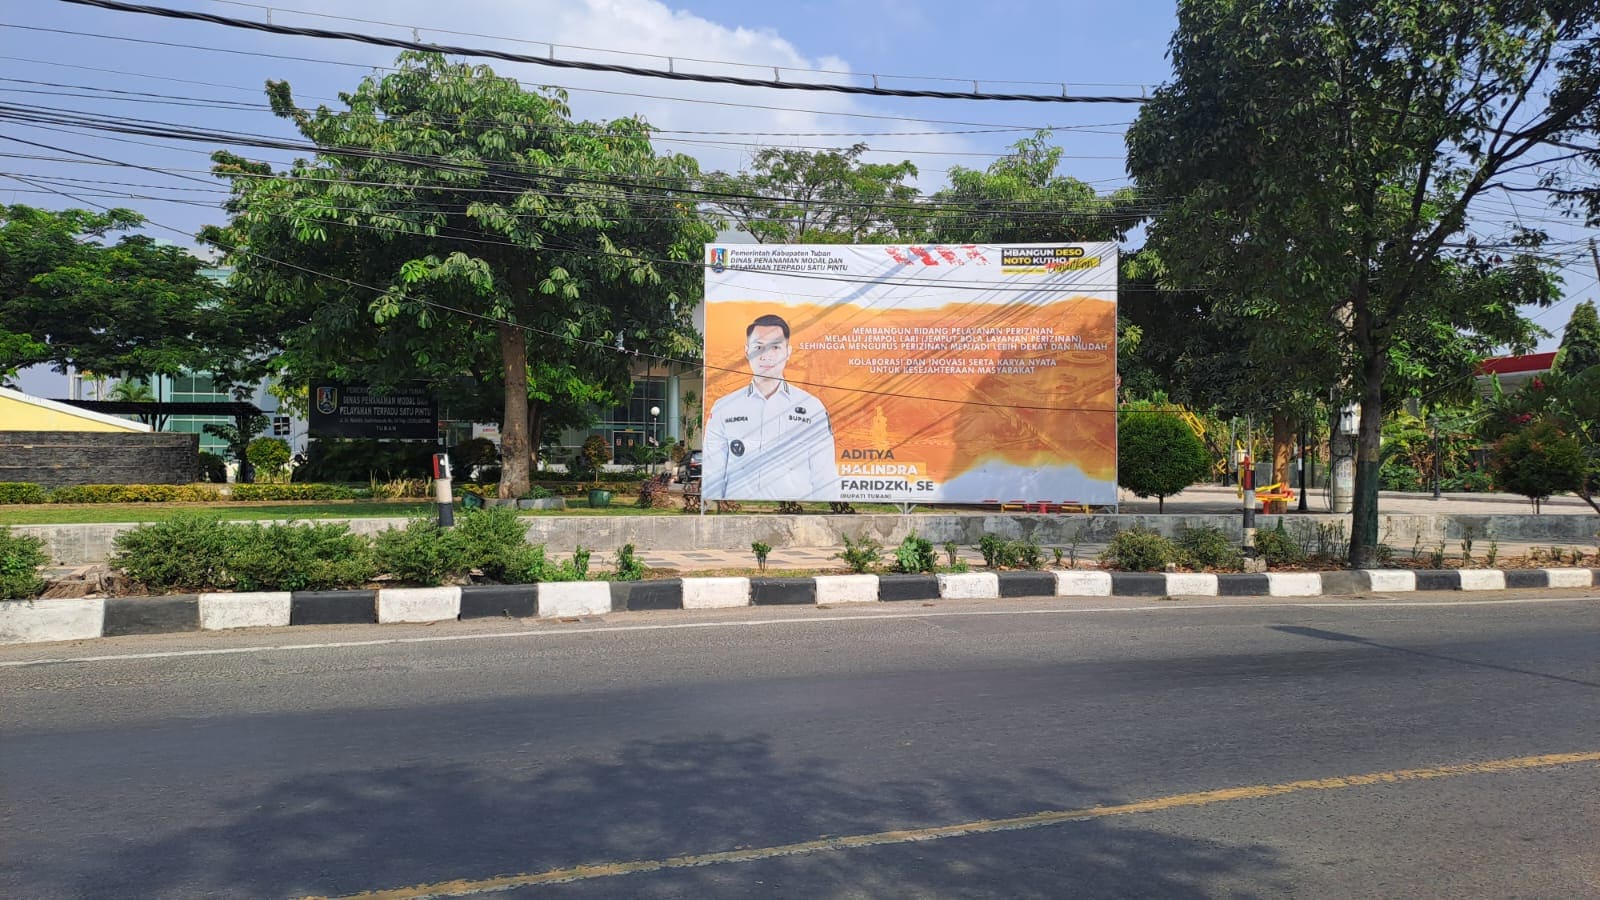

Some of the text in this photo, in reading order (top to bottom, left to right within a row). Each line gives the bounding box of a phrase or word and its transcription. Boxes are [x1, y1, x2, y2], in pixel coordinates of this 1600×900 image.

[772, 250, 808, 258] Kabupaten
[1003, 248, 1083, 257] MBANGUN DESO
[1003, 257, 1031, 265] NOTO
[1032, 257, 1067, 265] KUTHO
[852, 327, 1053, 335] MEMBANGUN BIDANG PELAYANAN PERIZINAN
[824, 335, 1082, 343] MELALUI JEMPOL LARI (JEMPUT BOLA LAYANAN PERIZINAN)
[848, 358, 1057, 366] KOLABORASI DAN INOVASI SERTA KARYA NYATA
[869, 366, 1036, 374] UNTUK KESEJAHTERAAN MASYARAKAT
[343, 396, 361, 405] DINAS
[339, 406, 432, 416] PELAYANAN TERPADU SATU PINTU
[788, 415, 812, 424] BUPATI
[841, 449, 895, 460] ADITYA
[841, 464, 918, 475] HALINDRA
[841, 480, 934, 493] FARIDZKI, SE
